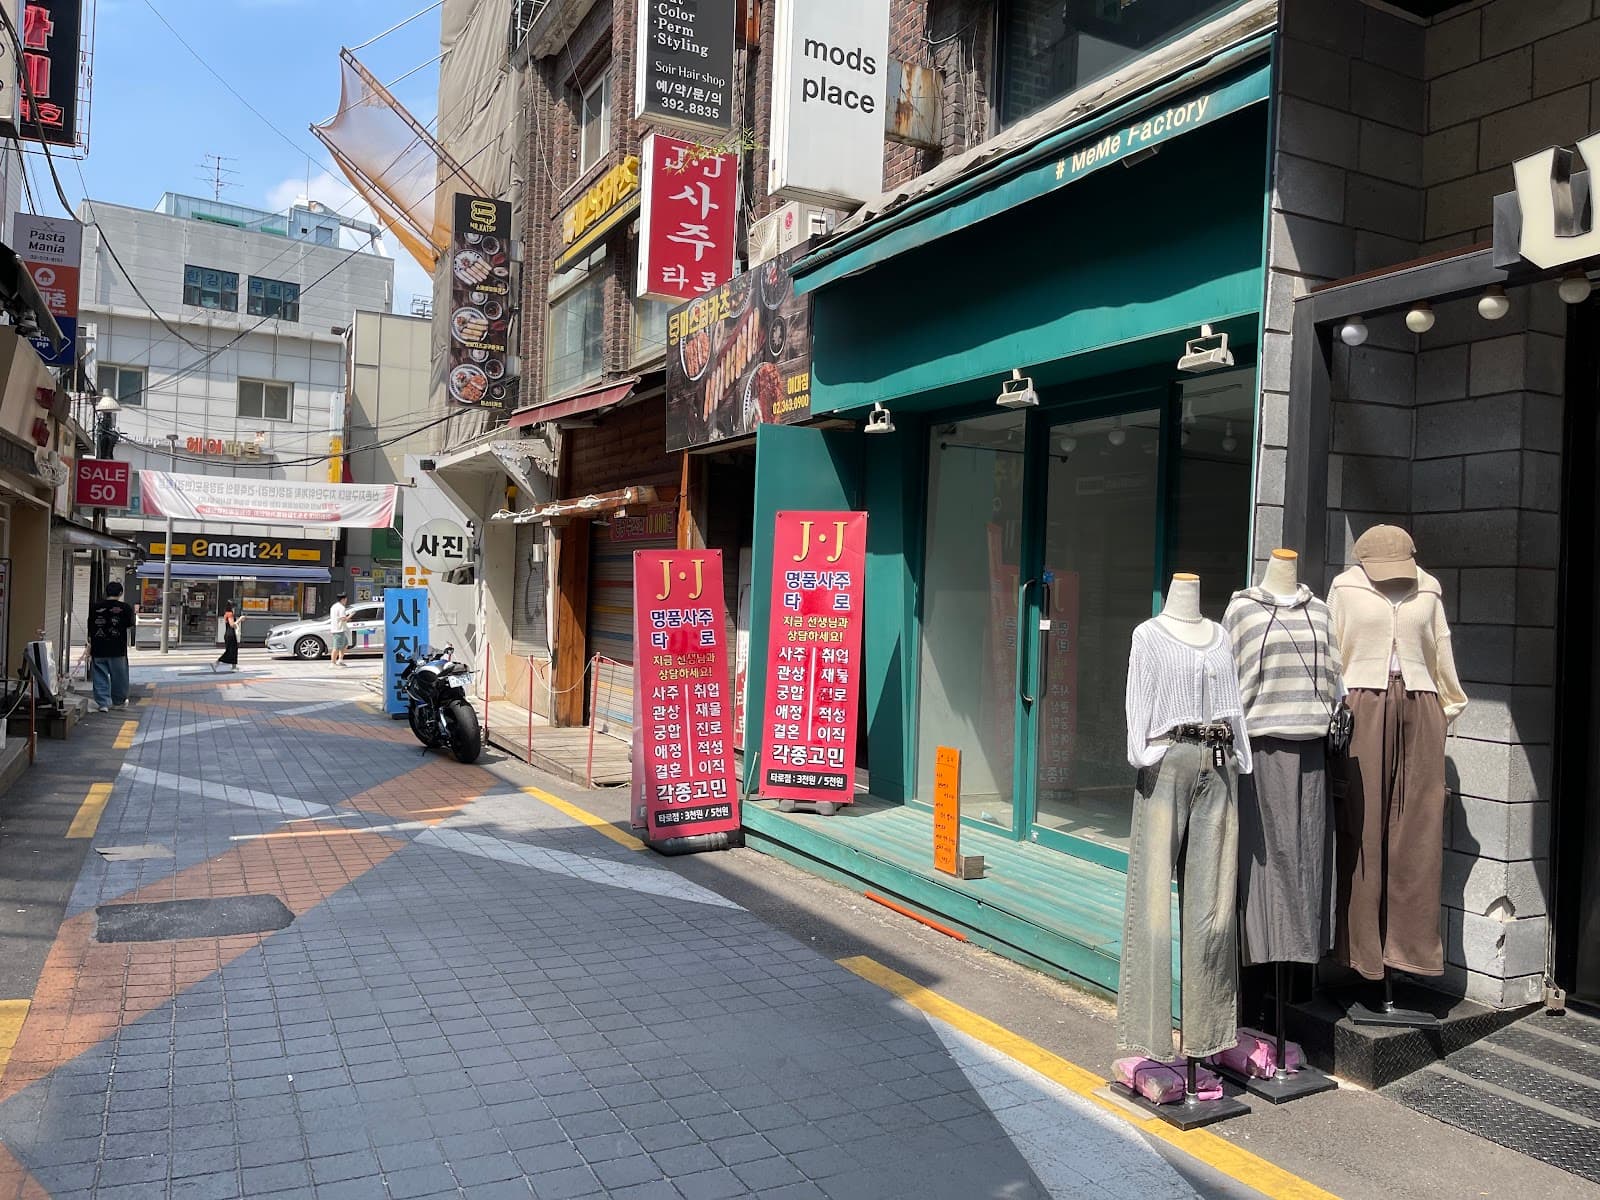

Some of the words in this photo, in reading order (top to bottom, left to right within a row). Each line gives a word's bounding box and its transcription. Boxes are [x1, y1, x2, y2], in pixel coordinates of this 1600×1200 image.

[658, 3, 696, 22] Color
[658, 17, 694, 37] Perm
[657, 32, 709, 58] Styling
[804, 38, 877, 75] mods
[655, 60, 677, 75] Soir
[678, 66, 700, 80] Hair
[702, 72, 725, 89] shop
[801, 75, 875, 114] place
[661, 97, 719, 119] 392.8835
[1071, 133, 1121, 173] MeMe
[1127, 95, 1209, 146] Factory
[30, 230, 65, 243] Pasta
[28, 241, 65, 254] Mania
[79, 467, 126, 482] SALE
[89, 484, 116, 501] 50
[416, 534, 463, 558] 사진
[785, 570, 850, 590] 명품사주
[650, 608, 713, 628] 명품사주
[784, 616, 803, 627] 지금
[808, 617, 848, 629] 선생님과
[788, 631, 843, 643] 상담하세요!
[779, 646, 807, 662] 사주
[821, 648, 849, 664] 취업
[659, 667, 713, 680] 상담하세요!
[777, 665, 805, 682] 관상
[821, 668, 848, 684] 재물
[652, 685, 679, 701] 사주
[694, 683, 720, 698] 취업
[777, 685, 804, 701] 궁합
[652, 705, 681, 721] 관상
[695, 702, 722, 717] 재물
[775, 705, 802, 721] 애정
[819, 707, 846, 723] 적성
[653, 724, 682, 740] 궁합
[696, 721, 722, 737] 진로
[773, 724, 800, 740] 결혼
[817, 727, 845, 743] 이직
[654, 743, 682, 759] 애정
[697, 740, 723, 756] 적성
[772, 744, 844, 768] 각종고민
[655, 762, 682, 779] 결혼
[699, 759, 725, 775] 이직
[656, 779, 727, 804] 각종고민
